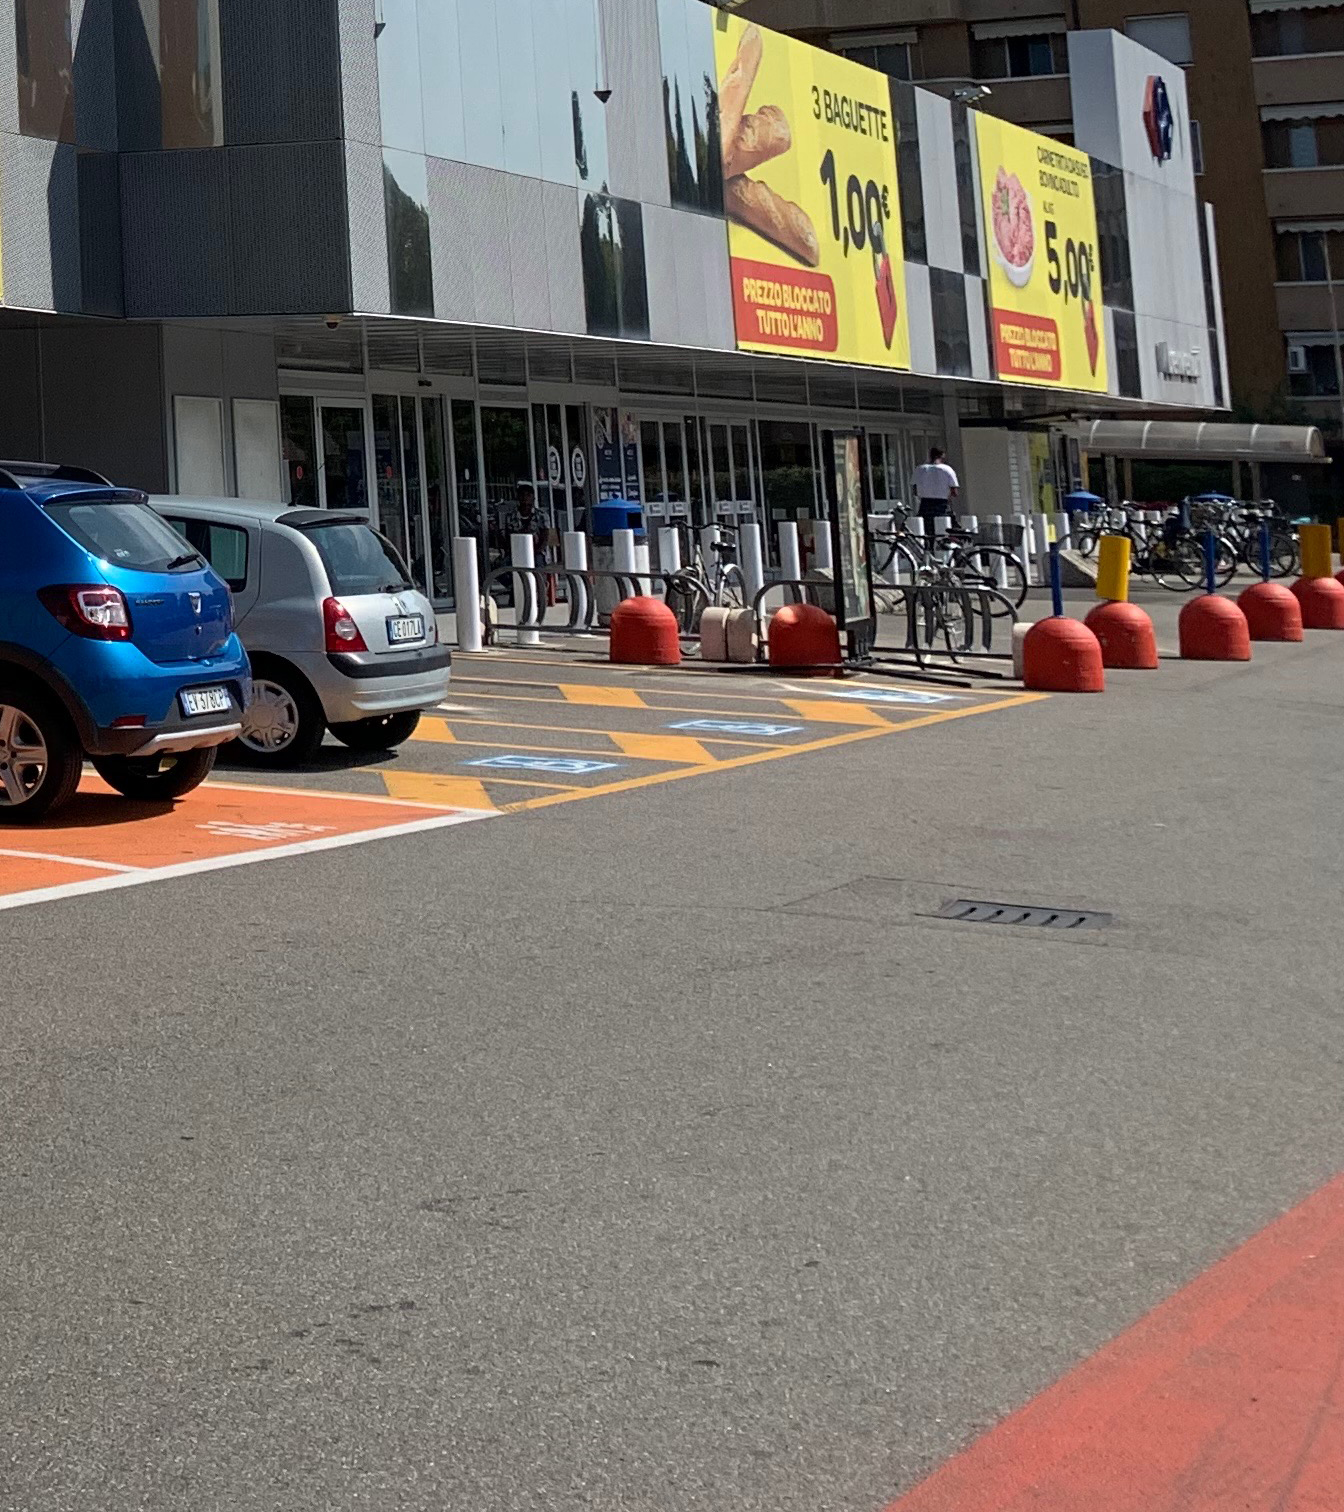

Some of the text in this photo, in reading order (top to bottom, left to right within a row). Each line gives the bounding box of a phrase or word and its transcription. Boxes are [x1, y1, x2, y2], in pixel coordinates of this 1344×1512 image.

[812, 85, 889, 142] 3 BAGUETTE
[742, 277, 832, 315] PREZZO BLOCCATO
[755, 308, 790, 338] TUTTO
[393, 620, 402, 637] CE
[187, 692, 199, 711] EV
